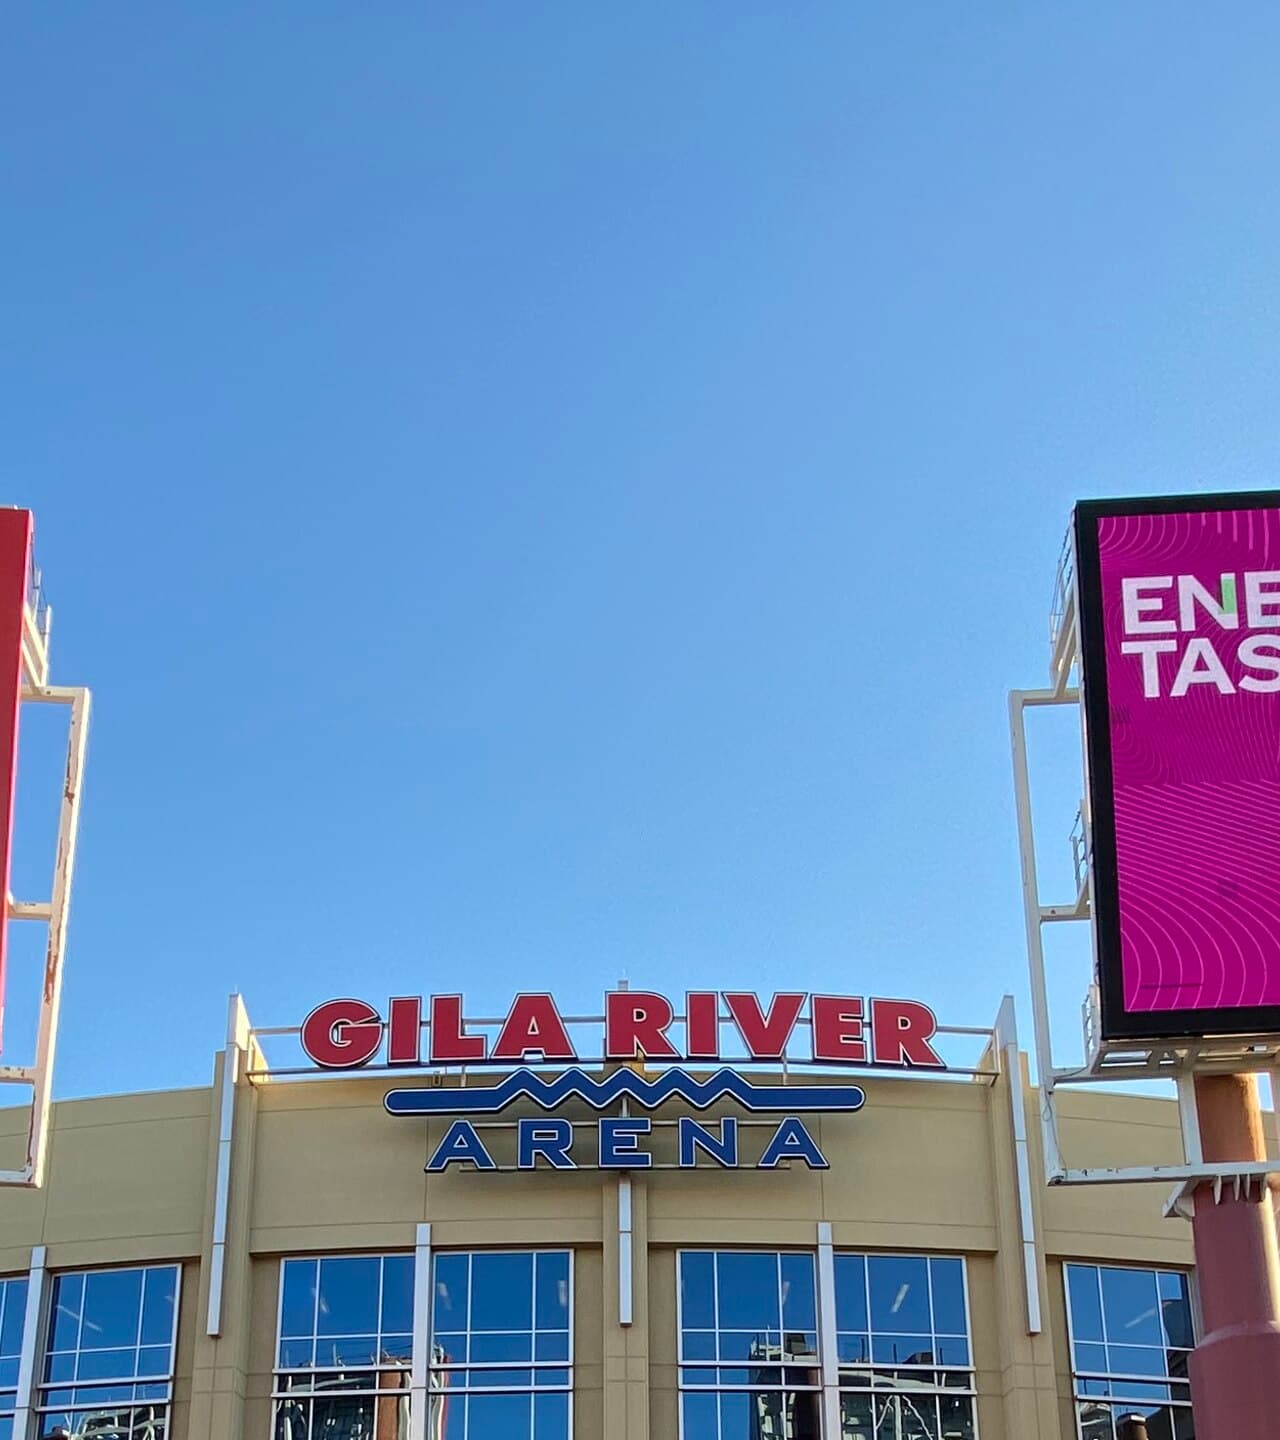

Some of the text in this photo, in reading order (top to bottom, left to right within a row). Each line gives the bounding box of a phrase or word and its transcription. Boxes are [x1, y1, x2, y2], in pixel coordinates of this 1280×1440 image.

[300, 990, 947, 1069] GILA RIVER
[425, 1116, 830, 1173] ARENA
